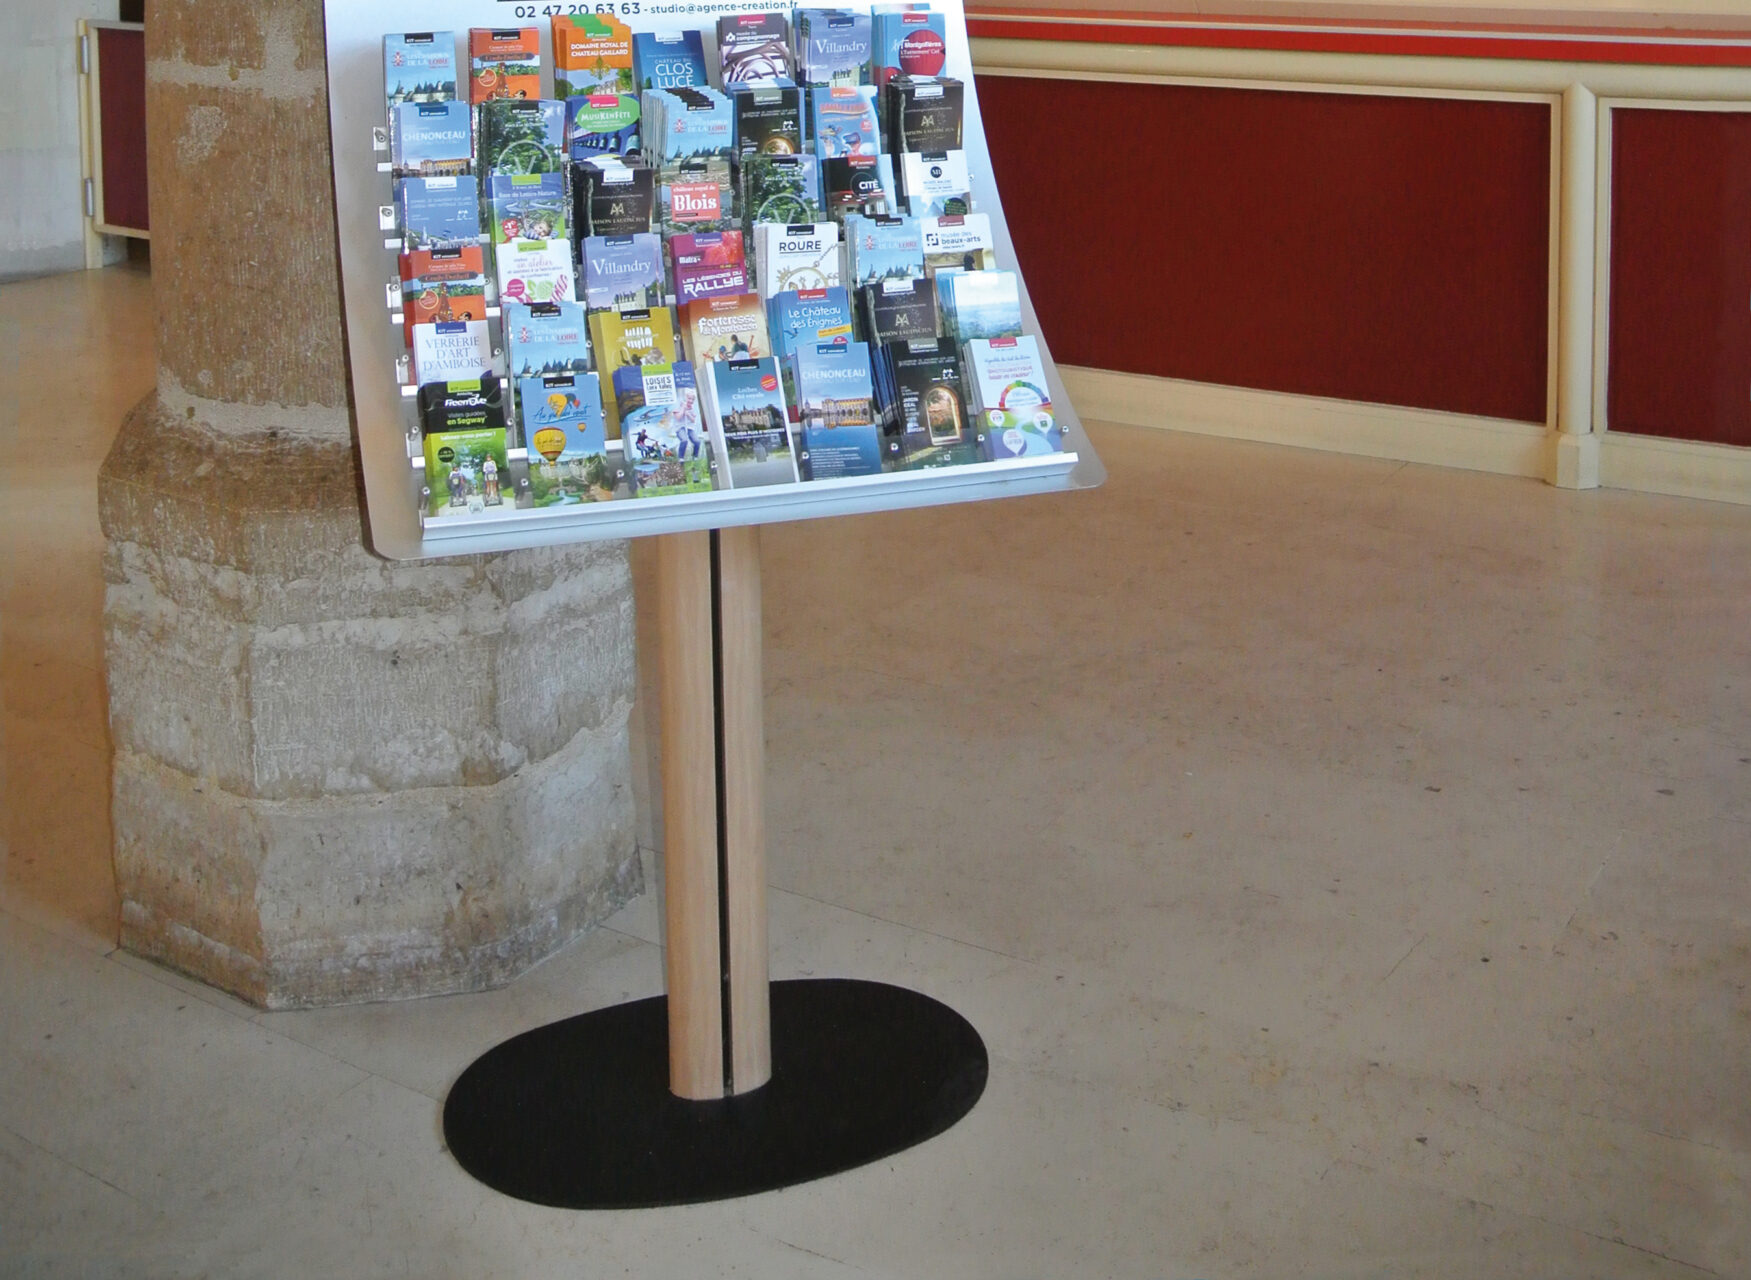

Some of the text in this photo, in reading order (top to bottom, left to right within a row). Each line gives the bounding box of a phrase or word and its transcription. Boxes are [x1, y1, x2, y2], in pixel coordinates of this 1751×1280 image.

[515, 0, 798, 19] 02 47 20 63 63 studio@agence-creation.fr
[815, 39, 867, 55] Villandry
[655, 62, 694, 76] CLOS
[403, 130, 466, 142] CHENONCEAU
[859, 179, 879, 190] CITÉ
[673, 194, 717, 212] Blois
[779, 240, 822, 252] ROURE
[941, 235, 981, 245] beaux-arts
[592, 258, 651, 276] Villandry
[684, 276, 744, 297] RALLYE
[788, 306, 841, 319] Le Château
[790, 320, 806, 329] des
[425, 336, 480, 349] VERRERIE
[436, 348, 470, 359] D'ART
[423, 357, 486, 371] D'AMBOISE
[802, 368, 866, 380] CHENONCEAU
